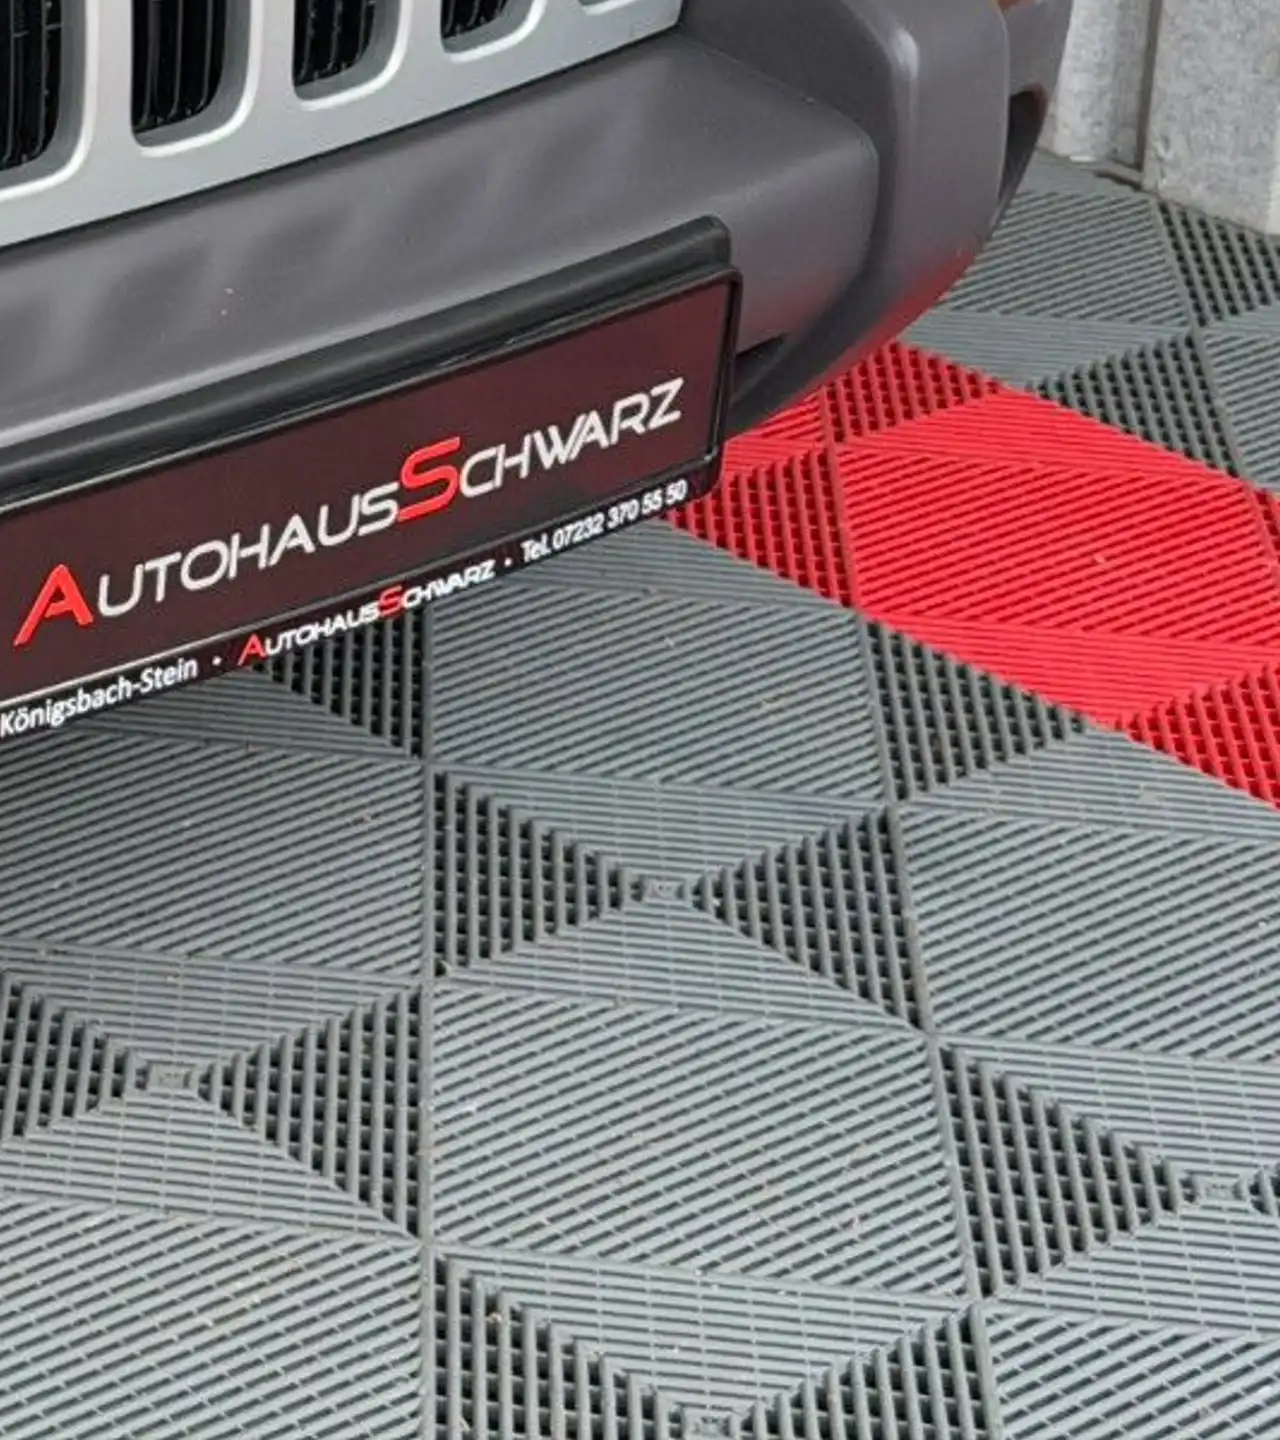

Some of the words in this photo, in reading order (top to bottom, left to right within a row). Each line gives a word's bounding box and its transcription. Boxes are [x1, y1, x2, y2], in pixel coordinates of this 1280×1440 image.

[552, 512, 605, 551] 07232
[607, 498, 639, 529] 370
[642, 488, 663, 514] 55
[665, 479, 688, 505] 50
